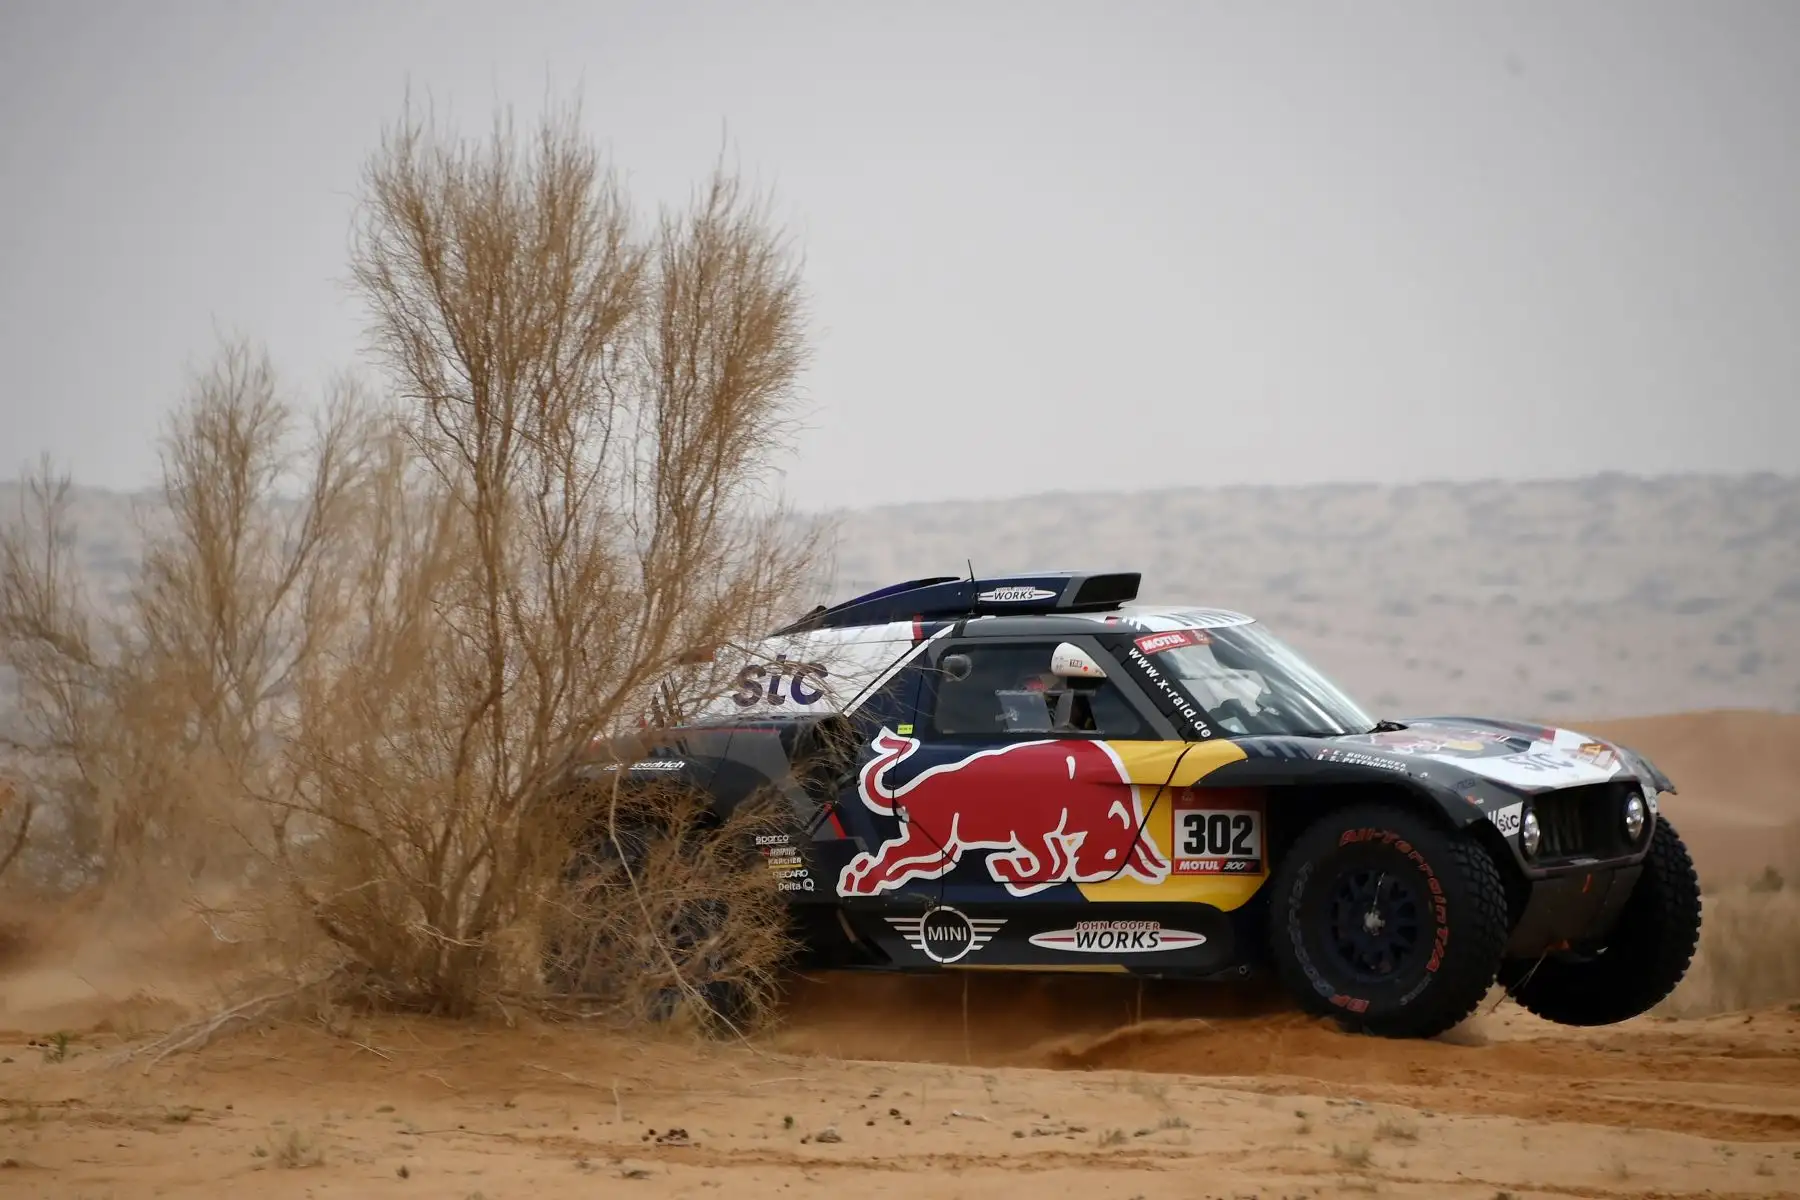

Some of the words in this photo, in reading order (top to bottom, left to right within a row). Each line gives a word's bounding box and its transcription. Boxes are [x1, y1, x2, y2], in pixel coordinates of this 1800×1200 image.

[994, 590, 1033, 600] WORKS
[1141, 634, 1187, 651] MOTUL
[1128, 647, 1212, 738] www.x-raid.de
[1499, 814, 1519, 832] stc
[756, 834, 789, 844] sparco
[1183, 814, 1253, 855] 302
[1179, 861, 1220, 870] MOTUL
[779, 882, 800, 891] Delta
[927, 925, 968, 941] MINI
[1075, 920, 1110, 931] JOHN
[1111, 920, 1161, 931] COOPER
[1075, 930, 1160, 949] WORKS
